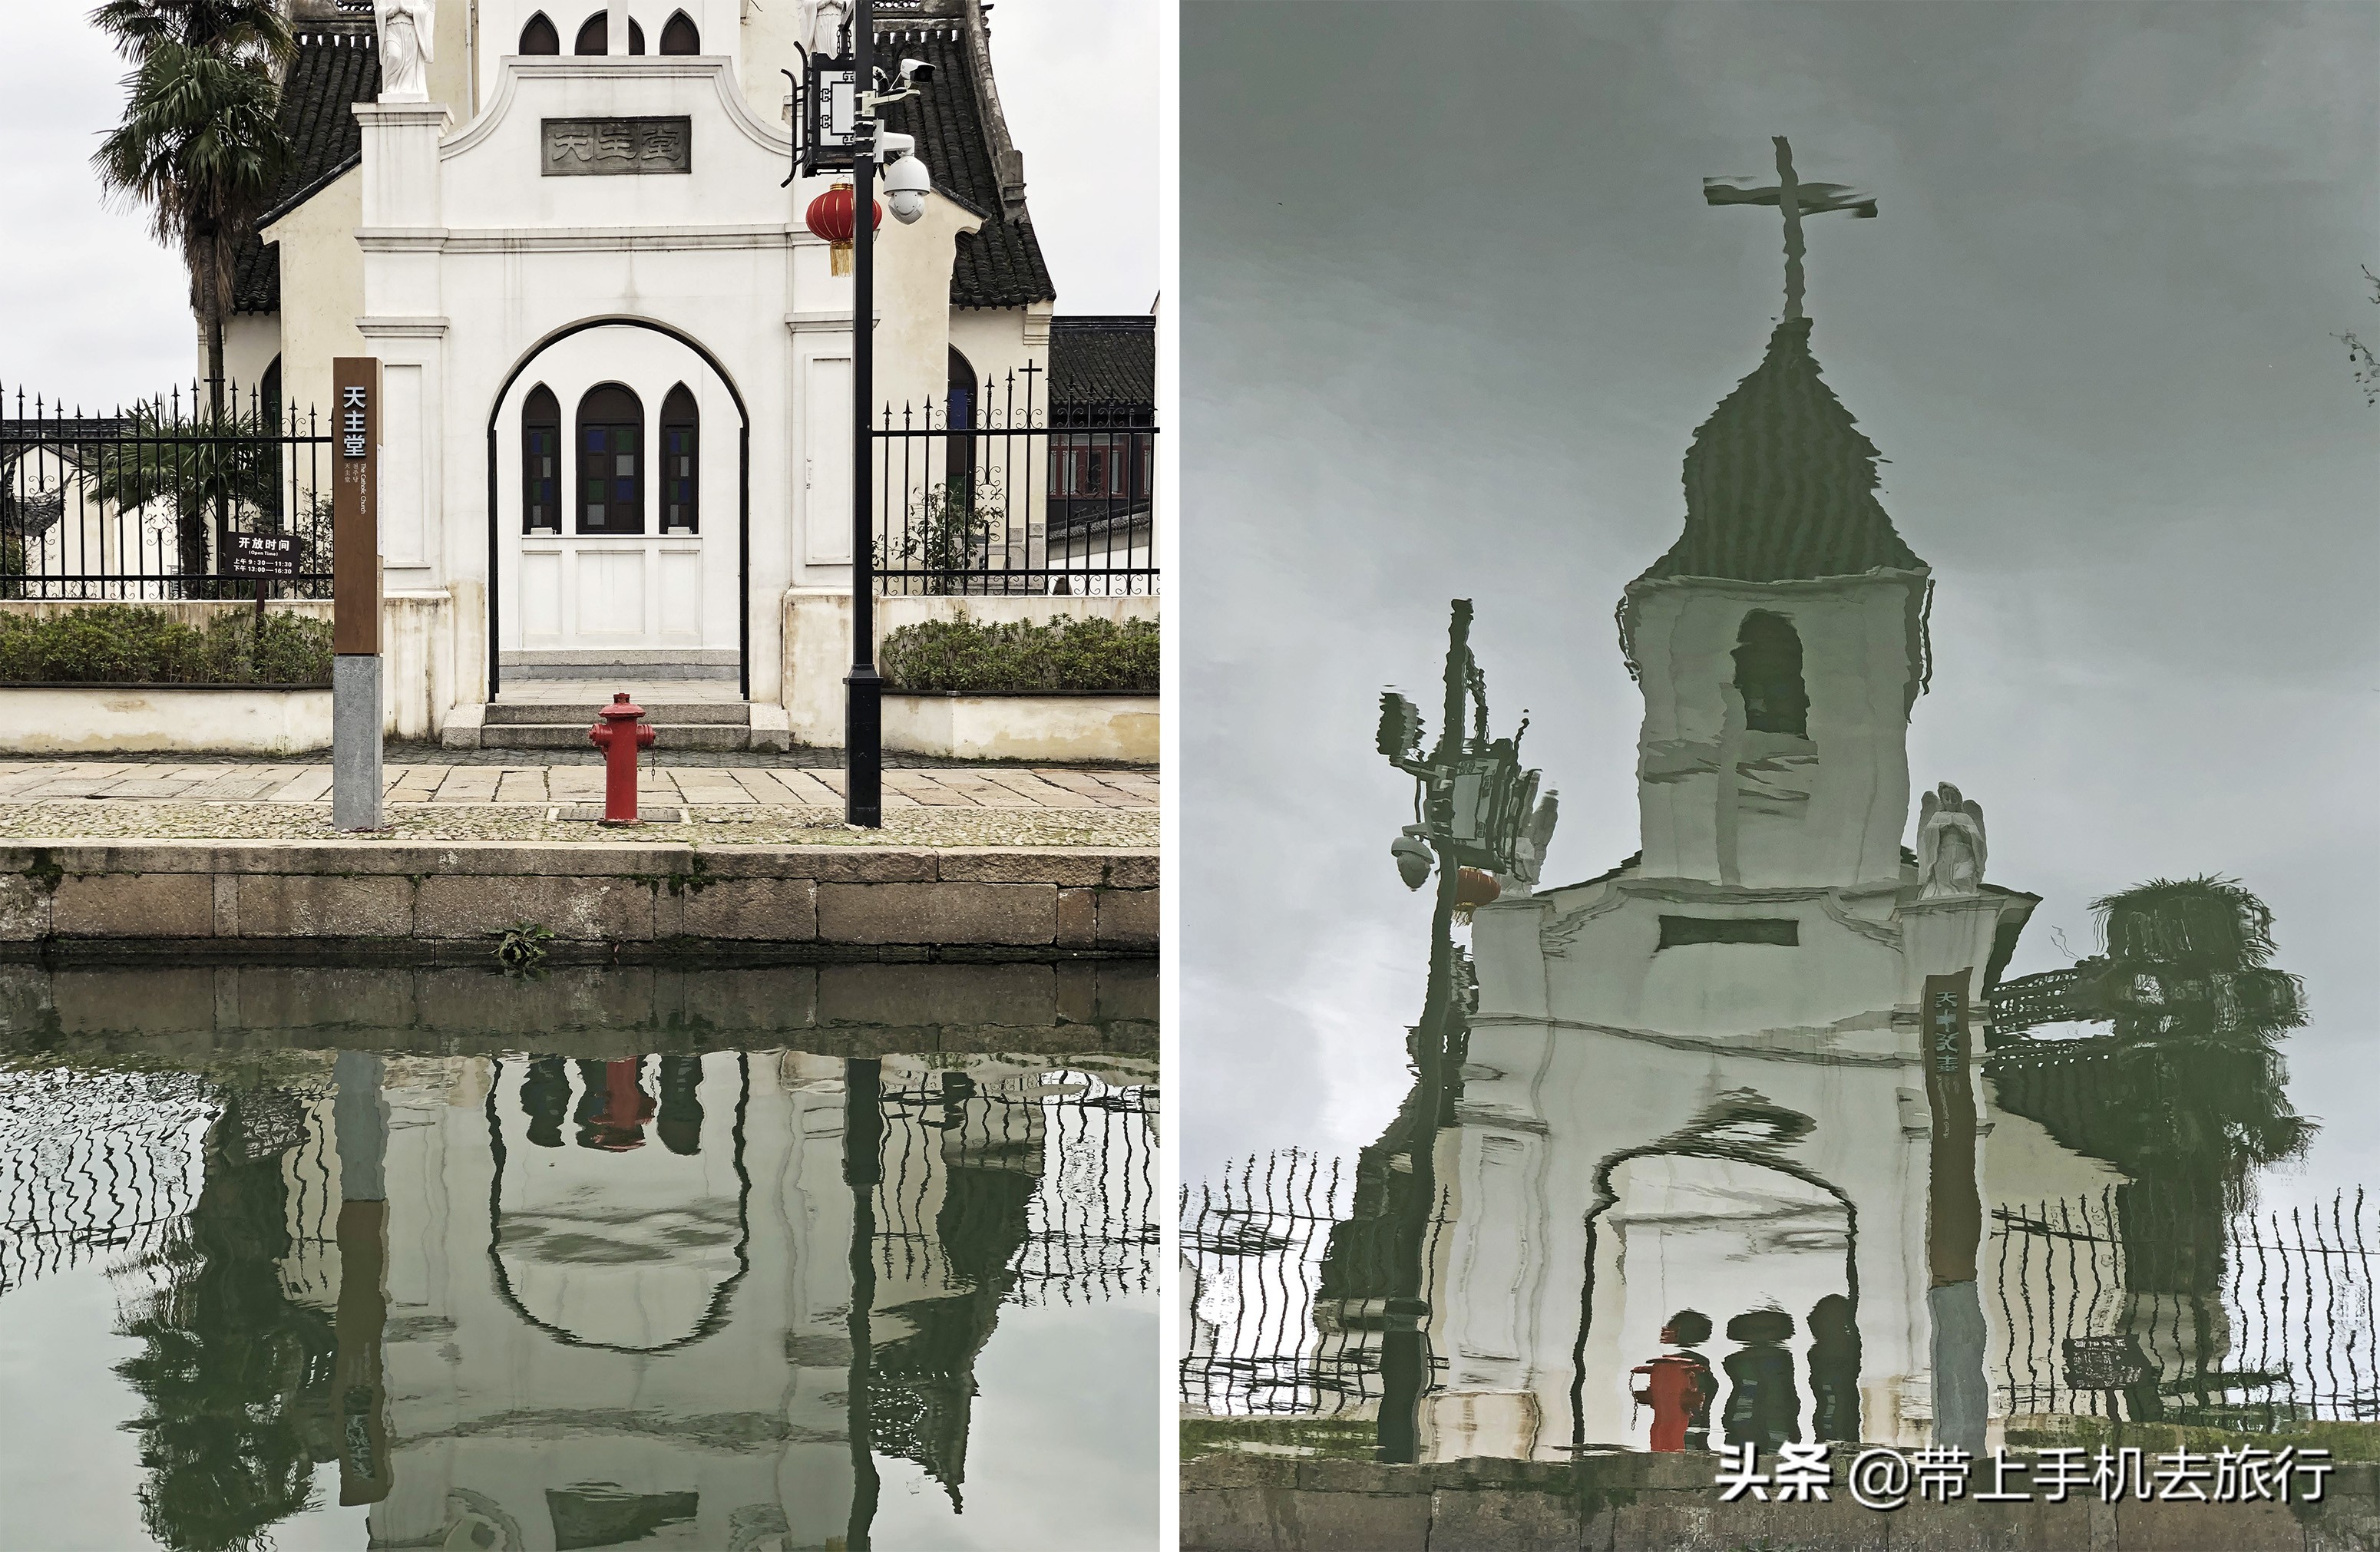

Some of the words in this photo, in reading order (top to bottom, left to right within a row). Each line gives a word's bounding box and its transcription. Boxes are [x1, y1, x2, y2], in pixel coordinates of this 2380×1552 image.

[552, 127, 682, 161] 天主堂
[343, 386, 366, 457] 天主堂
[238, 537, 289, 551] 开放时间
